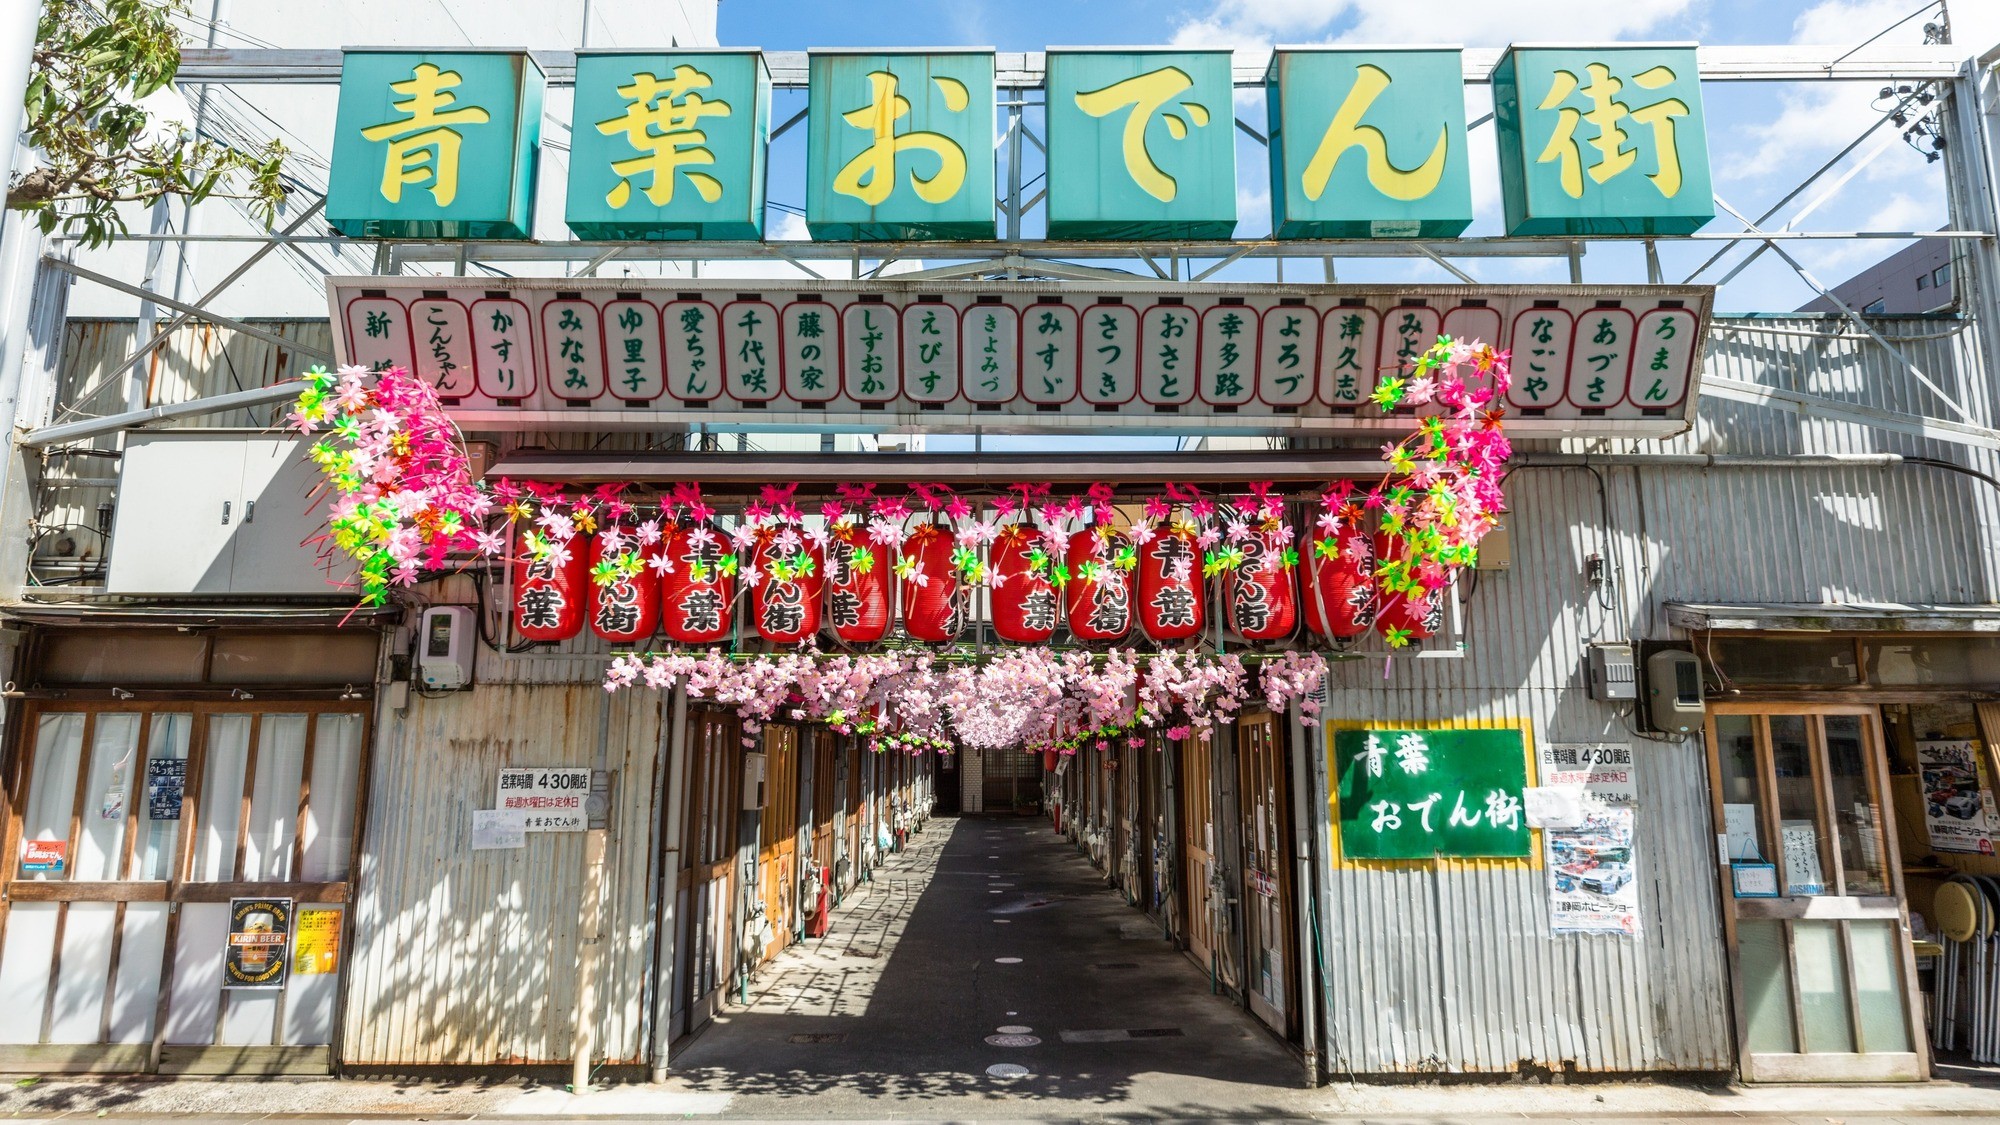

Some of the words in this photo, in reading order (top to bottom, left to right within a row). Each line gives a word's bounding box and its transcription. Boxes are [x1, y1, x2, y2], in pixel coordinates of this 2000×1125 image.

[360, 61, 1690, 207] 青葉おでん街
[427, 307, 457, 389] こんちゃん
[490, 309, 515, 391] かすり
[558, 309, 588, 389] みなみ
[618, 307, 647, 392] ゆ里子
[680, 307, 707, 394] 愛ちゃん
[738, 310, 768, 393] 千代咲
[797, 312, 825, 391] 藤の家
[860, 310, 885, 394] しずおか
[919, 311, 942, 394] えびす
[980, 314, 999, 392] きよみづ
[1097, 314, 1122, 397] さつき
[1159, 313, 1188, 397] おさと
[1214, 313, 1244, 397] 幸多路
[1274, 316, 1304, 396] よろづ
[1334, 314, 1365, 400] 津久志
[1523, 317, 1555, 400] なごや
[1587, 318, 1618, 402] あづさ
[1645, 317, 1677, 400] ろまん
[595, 533, 641, 634] おん街
[680, 541, 729, 634] 青葉
[1086, 535, 1130, 634] おん街
[1151, 534, 1198, 627] 青葉
[500, 773, 534, 789] 営業時間
[1354, 732, 1430, 778] 青葉
[1550, 771, 1628, 784] 毎週水曜日は定休日
[505, 796, 579, 809] 毎週水曜日は定休日
[1371, 788, 1522, 833] おでん街
[234, 935, 258, 943] KIRIN
[260, 935, 282, 943] BEER
[1562, 901, 1634, 913] 静岡ホビーショー
